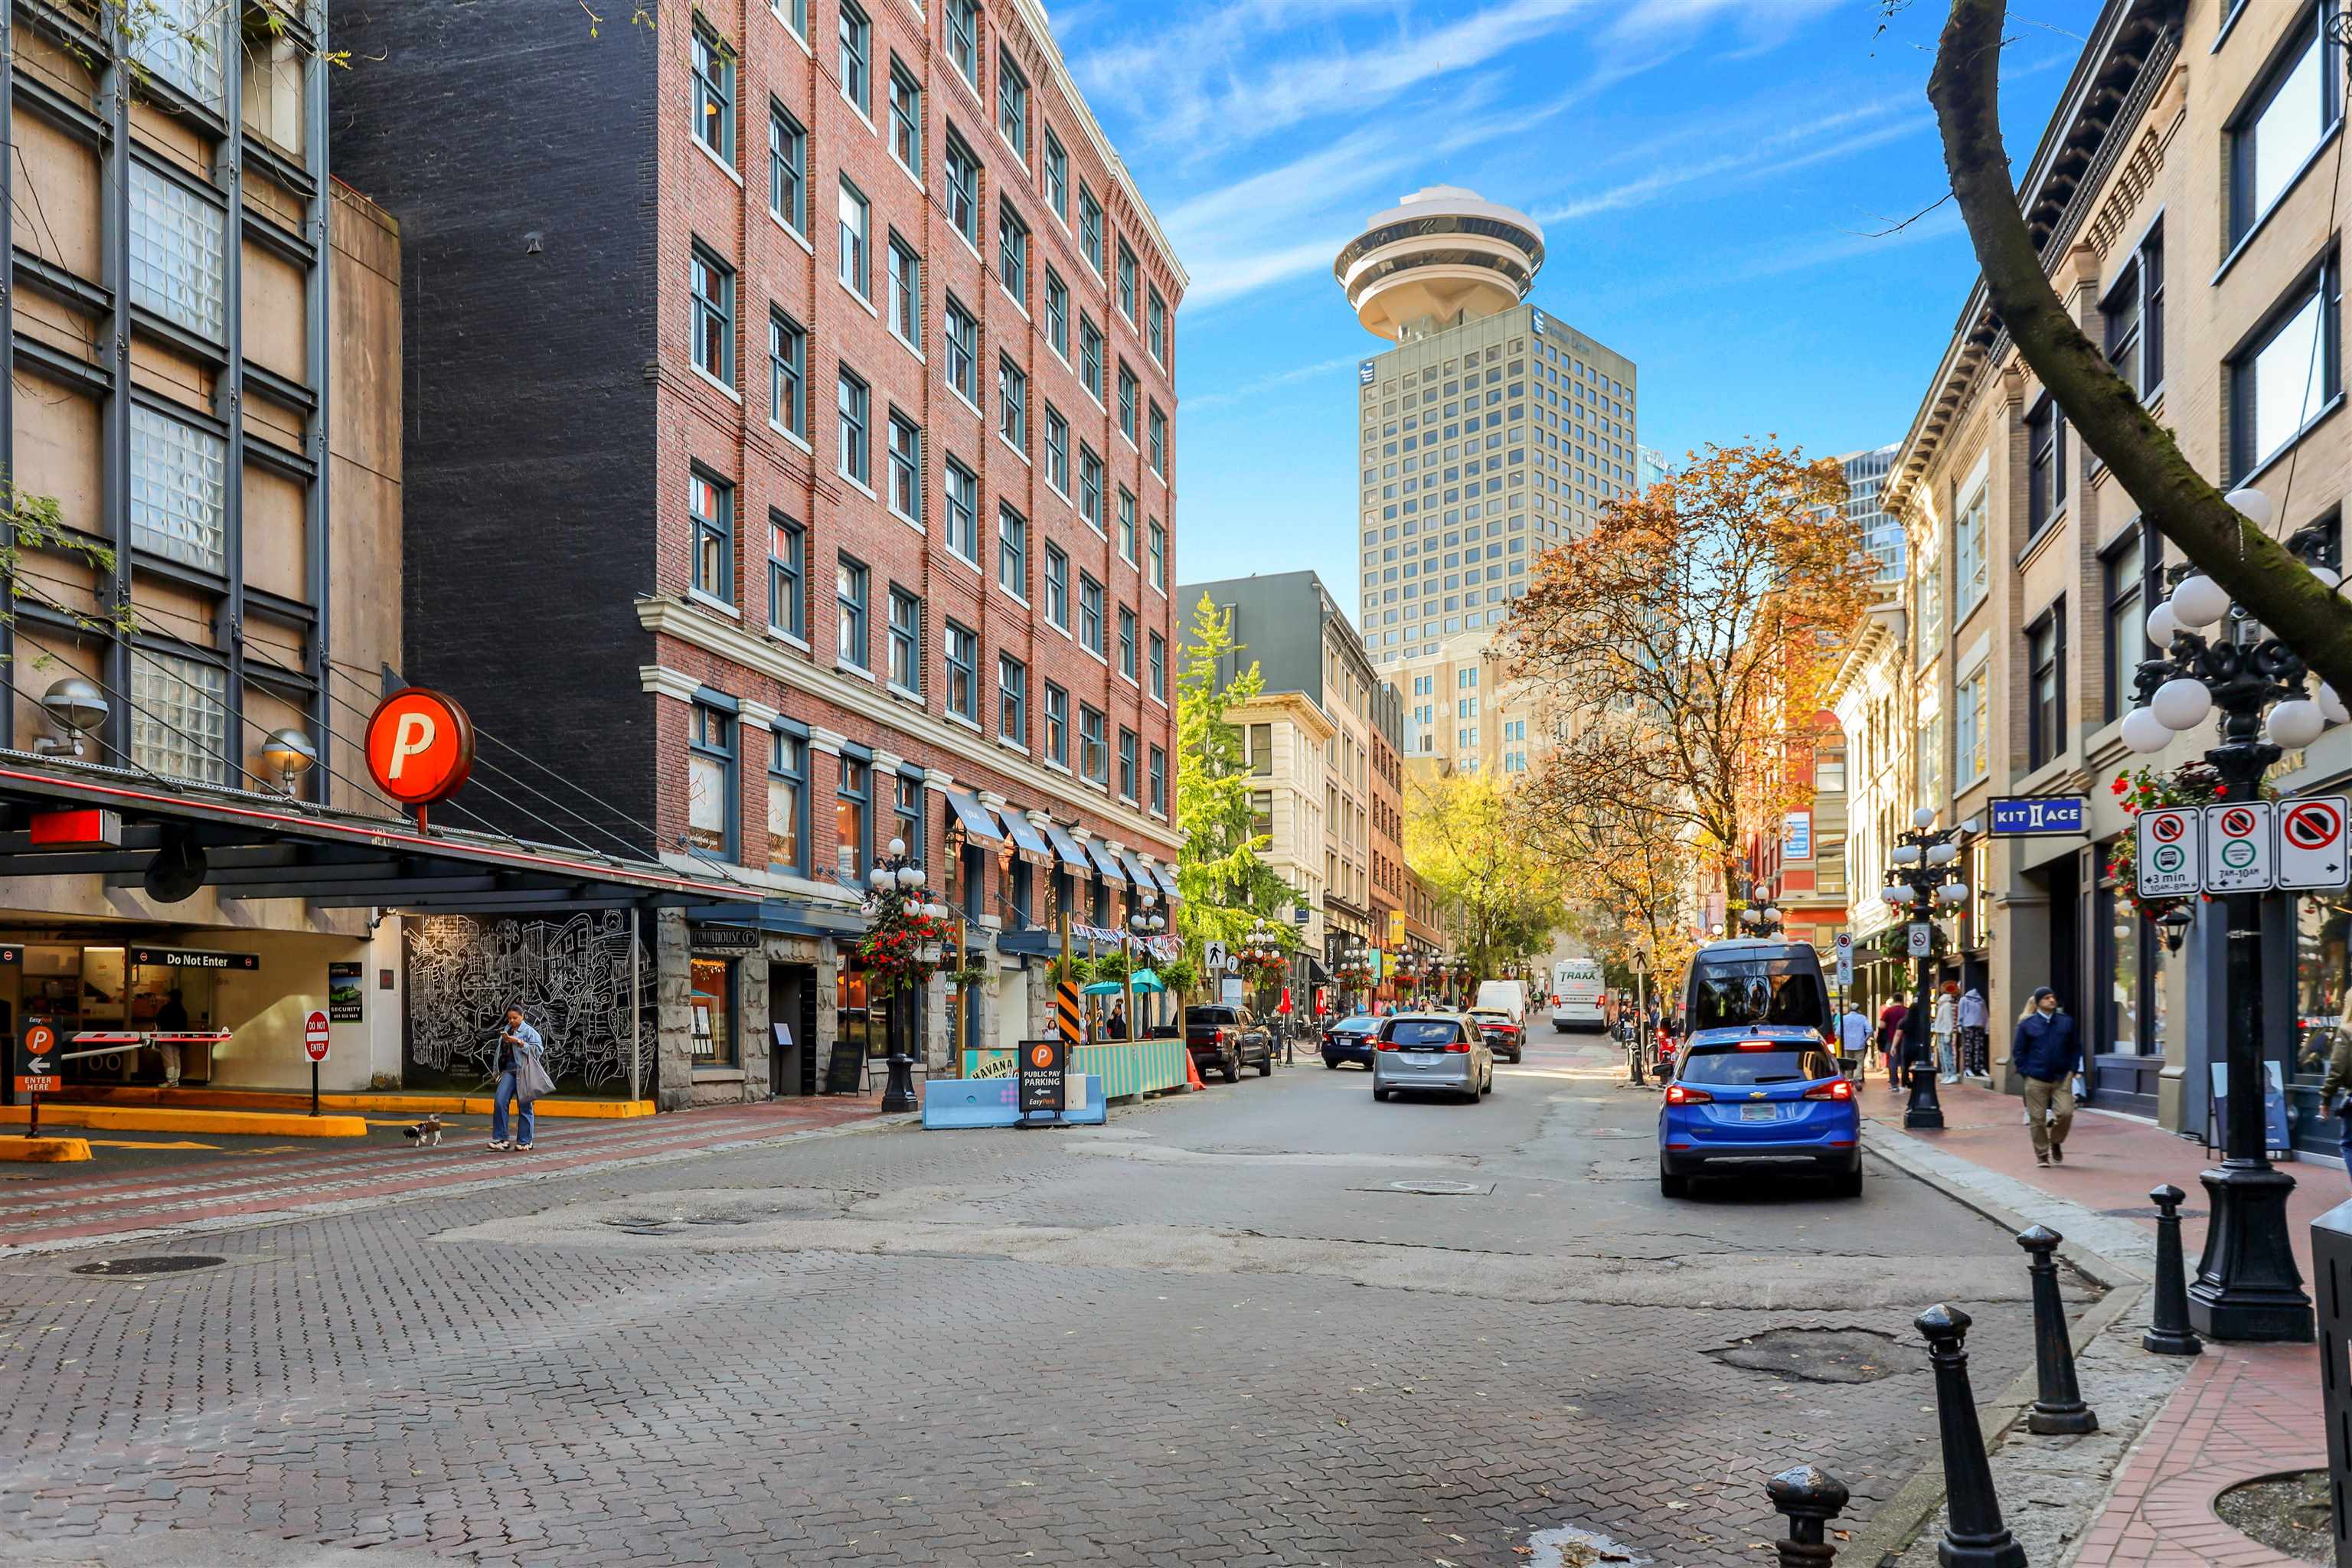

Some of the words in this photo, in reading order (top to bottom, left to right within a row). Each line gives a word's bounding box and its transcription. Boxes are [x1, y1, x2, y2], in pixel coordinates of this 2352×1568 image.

[389, 713, 436, 779] P
[1997, 811, 2027, 822] KIT
[2045, 809, 2079, 821] ACE
[2153, 874, 2159, 884] 3
[2162, 872, 2186, 883] min
[2220, 867, 2259, 879] 7AM-10AM
[2150, 882, 2190, 892] 10AM-8PM
[167, 953, 181, 965] Do
[183, 955, 201, 965] Not
[203, 956, 227, 967] Enter
[1560, 971, 1596, 982] TRAXX
[309, 1021, 315, 1030] DO
[316, 1021, 325, 1030] NOT
[33, 1031, 47, 1050] P
[310, 1043, 325, 1053] ENTER
[1037, 1048, 1047, 1063] P
[972, 1059, 1013, 1079] HAVANA
[1029, 1098, 1056, 1106] EasyPark
